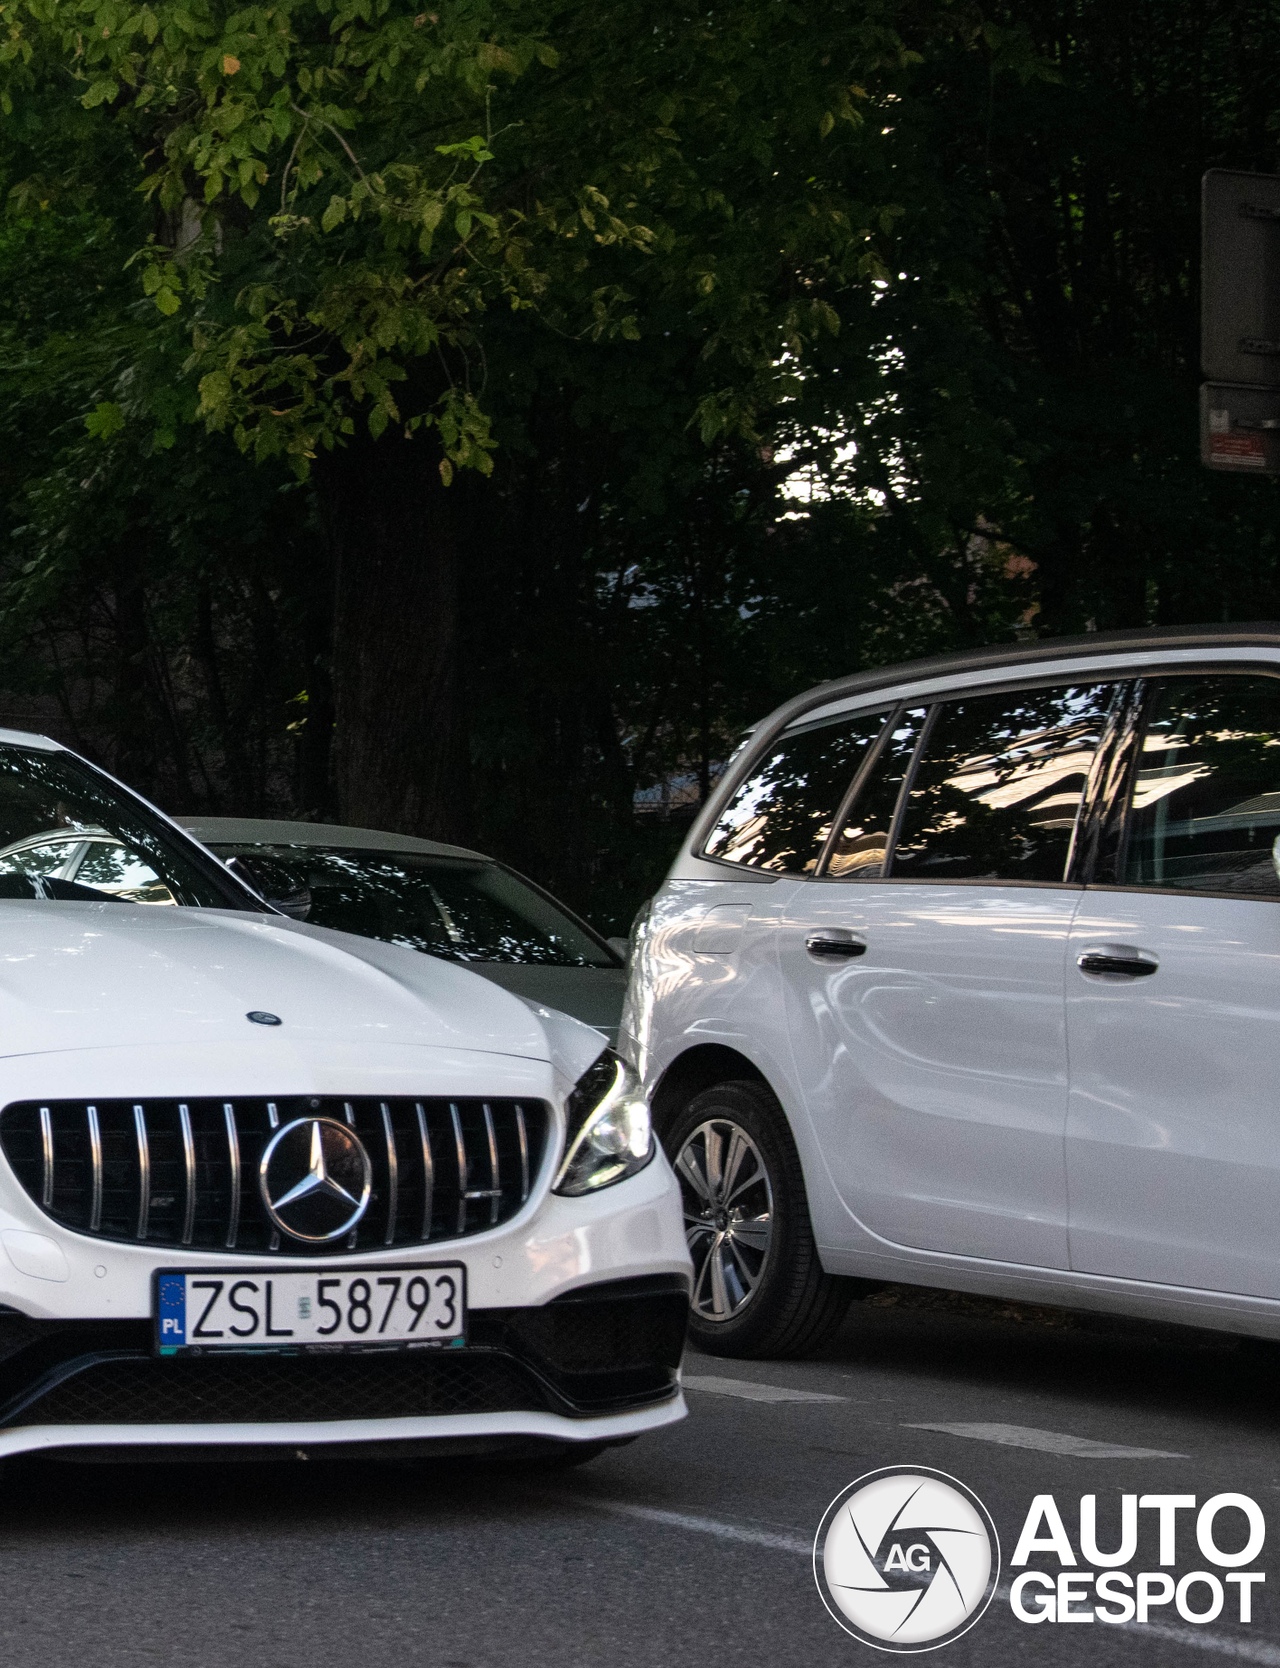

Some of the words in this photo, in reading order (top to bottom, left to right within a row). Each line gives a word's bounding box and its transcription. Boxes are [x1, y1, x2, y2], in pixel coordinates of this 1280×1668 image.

[163, 1318, 183, 1334] PL
[191, 1280, 293, 1338] ZSL
[316, 1275, 457, 1335] 58793
